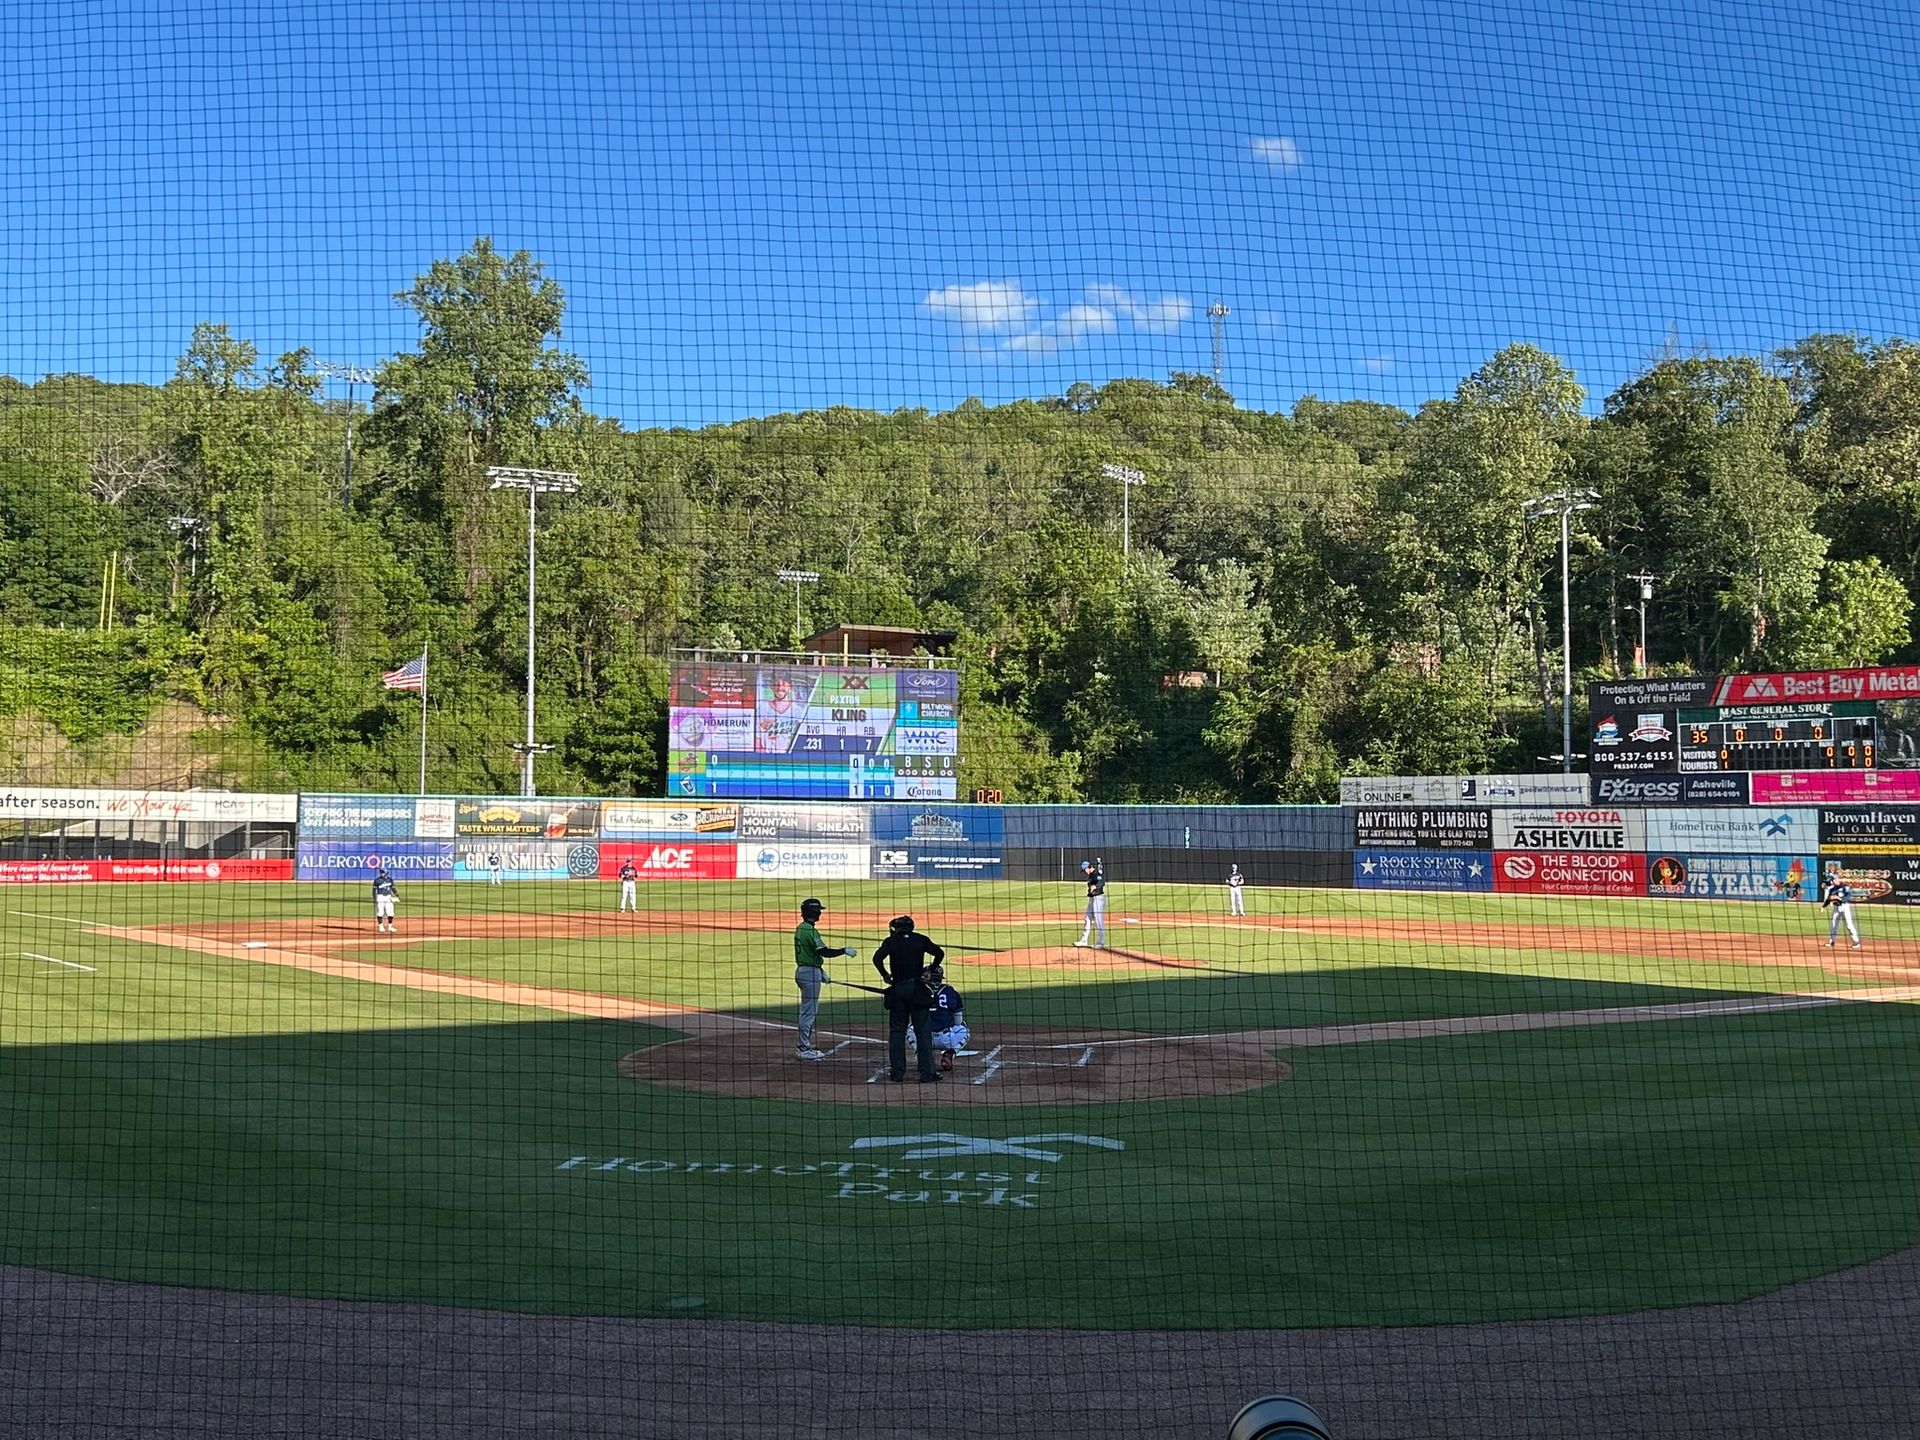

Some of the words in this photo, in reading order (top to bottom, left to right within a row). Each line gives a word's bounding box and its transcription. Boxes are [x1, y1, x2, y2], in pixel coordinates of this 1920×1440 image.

[914, 674, 940, 686] Ford
[1600, 684, 1644, 695] Protecting
[1646, 682, 1669, 692] What
[1671, 681, 1706, 690] Matters
[1784, 676, 1824, 696] Best
[1830, 675, 1864, 698] Buy
[830, 696, 860, 705] PAXTON
[1614, 696, 1626, 704] On
[1628, 696, 1636, 704] &
[1637, 695, 1650, 704] Off
[1653, 694, 1667, 703] the
[1668, 692, 1691, 702] Field
[832, 709, 866, 722] KLING
[1719, 706, 1747, 720] MAST
[1750, 705, 1796, 715] GENERAL
[1798, 703, 1832, 716] STORE
[806, 726, 820, 734] AVG
[837, 726, 846, 734] HR
[1736, 730, 1744, 742] 0
[1774, 728, 1782, 740] 0
[1814, 727, 1822, 739] 0
[904, 730, 948, 744] WNC
[1692, 731, 1708, 744] 35
[840, 740, 844, 750] 1
[866, 740, 872, 750] 7
[1682, 751, 1716, 760] VISITORS
[1721, 750, 1728, 760] 0
[1826, 747, 1834, 757] 0
[1848, 746, 1855, 756] 0
[1864, 746, 1872, 756] 0
[712, 754, 718, 765] 0
[853, 758, 858, 768] 0
[870, 758, 874, 769] 0
[884, 759, 890, 769] 0
[905, 756, 912, 767] B
[925, 756, 931, 768] S
[1682, 762, 1718, 770] TOURISTS
[1864, 758, 1872, 767] 0
[1692, 780, 1736, 789] Asheville
[885, 786, 890, 796] 0
[907, 786, 942, 798] Corona
[1364, 792, 1402, 802] ONLINE
[42, 798, 100, 809] season.
[107, 794, 128, 812] We
[215, 800, 237, 808] HCA
[743, 817, 798, 827] MOUNTAIN
[1358, 812, 1418, 828] ANYTHING
[1422, 812, 1488, 828] PLUMBING
[1556, 812, 1621, 824] TOYOTA
[1824, 811, 1916, 823] BrownHaven
[458, 824, 482, 833] TASTE
[482, 825, 505, 834] WHAT
[743, 827, 776, 836] LIVING
[816, 822, 864, 832] SINEATH
[1670, 822, 1726, 831] HomeTrust
[1728, 822, 1755, 831] Bank
[1838, 824, 1902, 833] HOMES
[1358, 830, 1369, 838] TRY
[1370, 830, 1398, 838] ANYTHING
[1439, 830, 1446, 838] BE
[1448, 830, 1463, 838] GLAD
[1514, 830, 1624, 848] ASHEVILLE
[300, 856, 366, 868] ALLERGY
[382, 854, 454, 868] PARTNERS
[510, 852, 559, 870] SMILES
[642, 844, 694, 868] ACE
[782, 852, 848, 860] CHAMPION
[1540, 855, 1567, 867] THE
[1572, 856, 1619, 868] BLOOD
[1379, 856, 1417, 868] ROCK
[1424, 857, 1461, 869] STAR
[1380, 868, 1414, 878] MARBLE
[1425, 870, 1462, 879] GRANITE
[1541, 869, 1634, 882] CONNECTION
[1688, 872, 1710, 894] 75
[1712, 874, 1778, 896] YEARS
[555, 1156, 1051, 1184] HomeTrust
[825, 1182, 1039, 1207] Park
